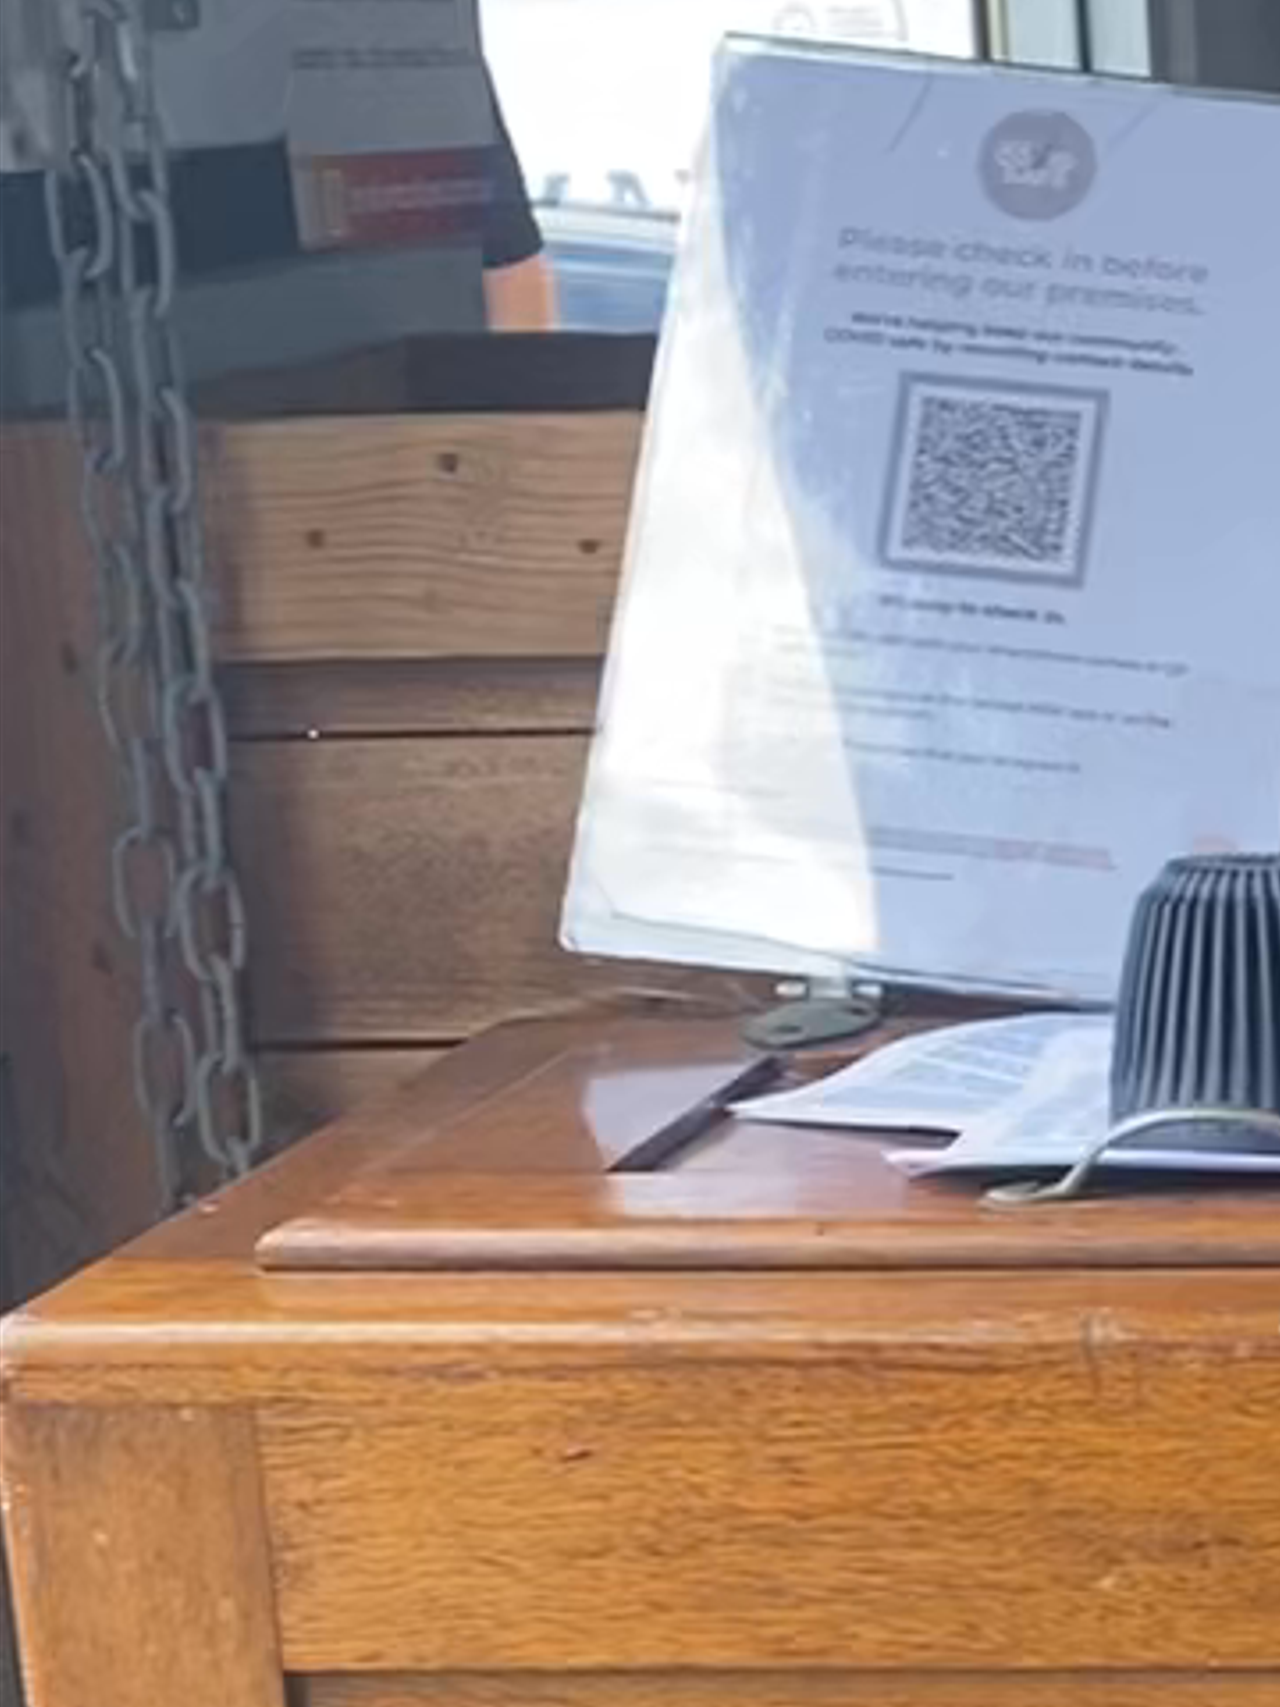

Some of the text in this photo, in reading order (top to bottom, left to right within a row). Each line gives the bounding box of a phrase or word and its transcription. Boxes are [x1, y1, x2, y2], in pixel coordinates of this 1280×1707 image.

[838, 227, 1210, 283] Please check in before
[832, 263, 973, 298] entering
[980, 276, 1037, 298] our
